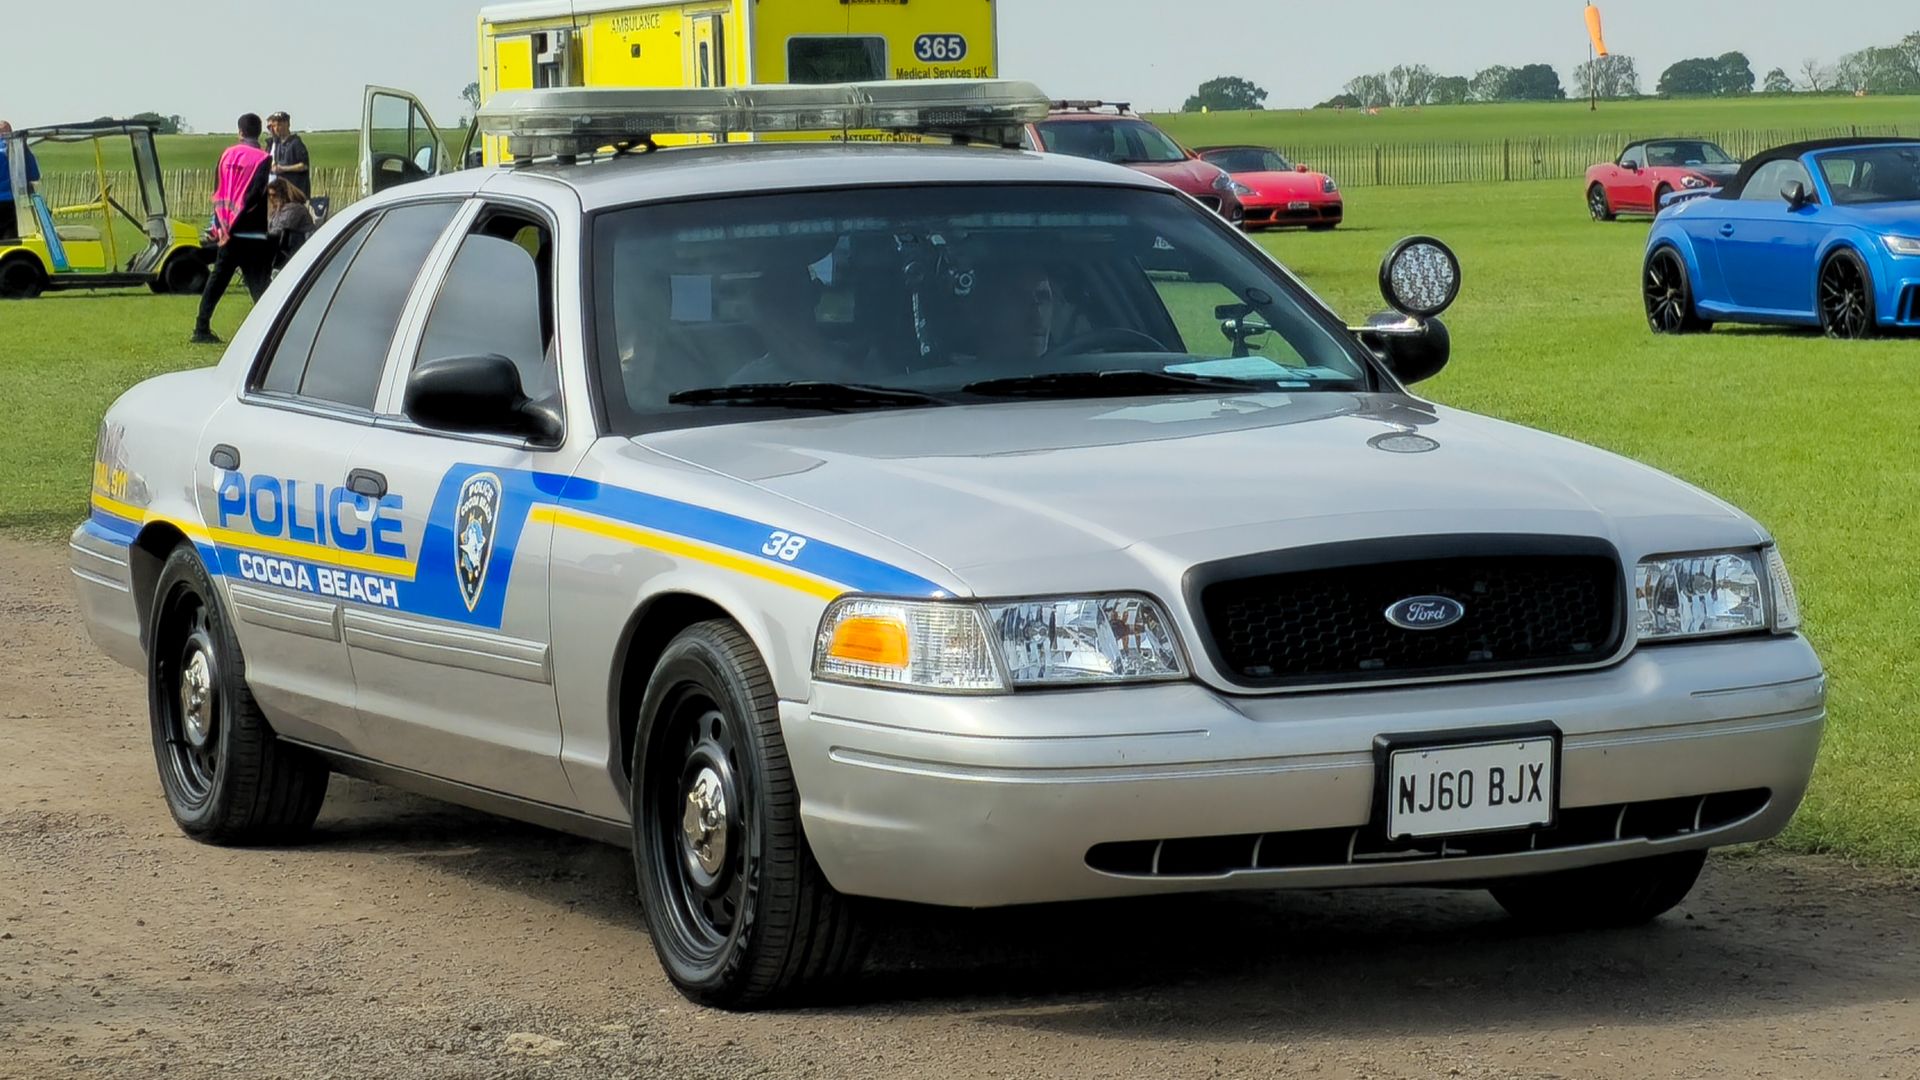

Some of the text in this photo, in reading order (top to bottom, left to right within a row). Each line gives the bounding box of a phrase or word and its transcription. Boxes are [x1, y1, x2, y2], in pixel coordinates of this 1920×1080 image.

[610, 13, 661, 33] AMBULANCE
[918, 37, 961, 58] 365
[896, 65, 989, 80] Medical Services UK
[469, 481, 494, 503] POLICE
[217, 471, 407, 559] POLICE
[761, 530, 807, 562] 38
[238, 553, 400, 608] COCOA BEACH
[1406, 602, 1445, 622] Ford
[1399, 762, 1544, 815] NJ60 BJX
